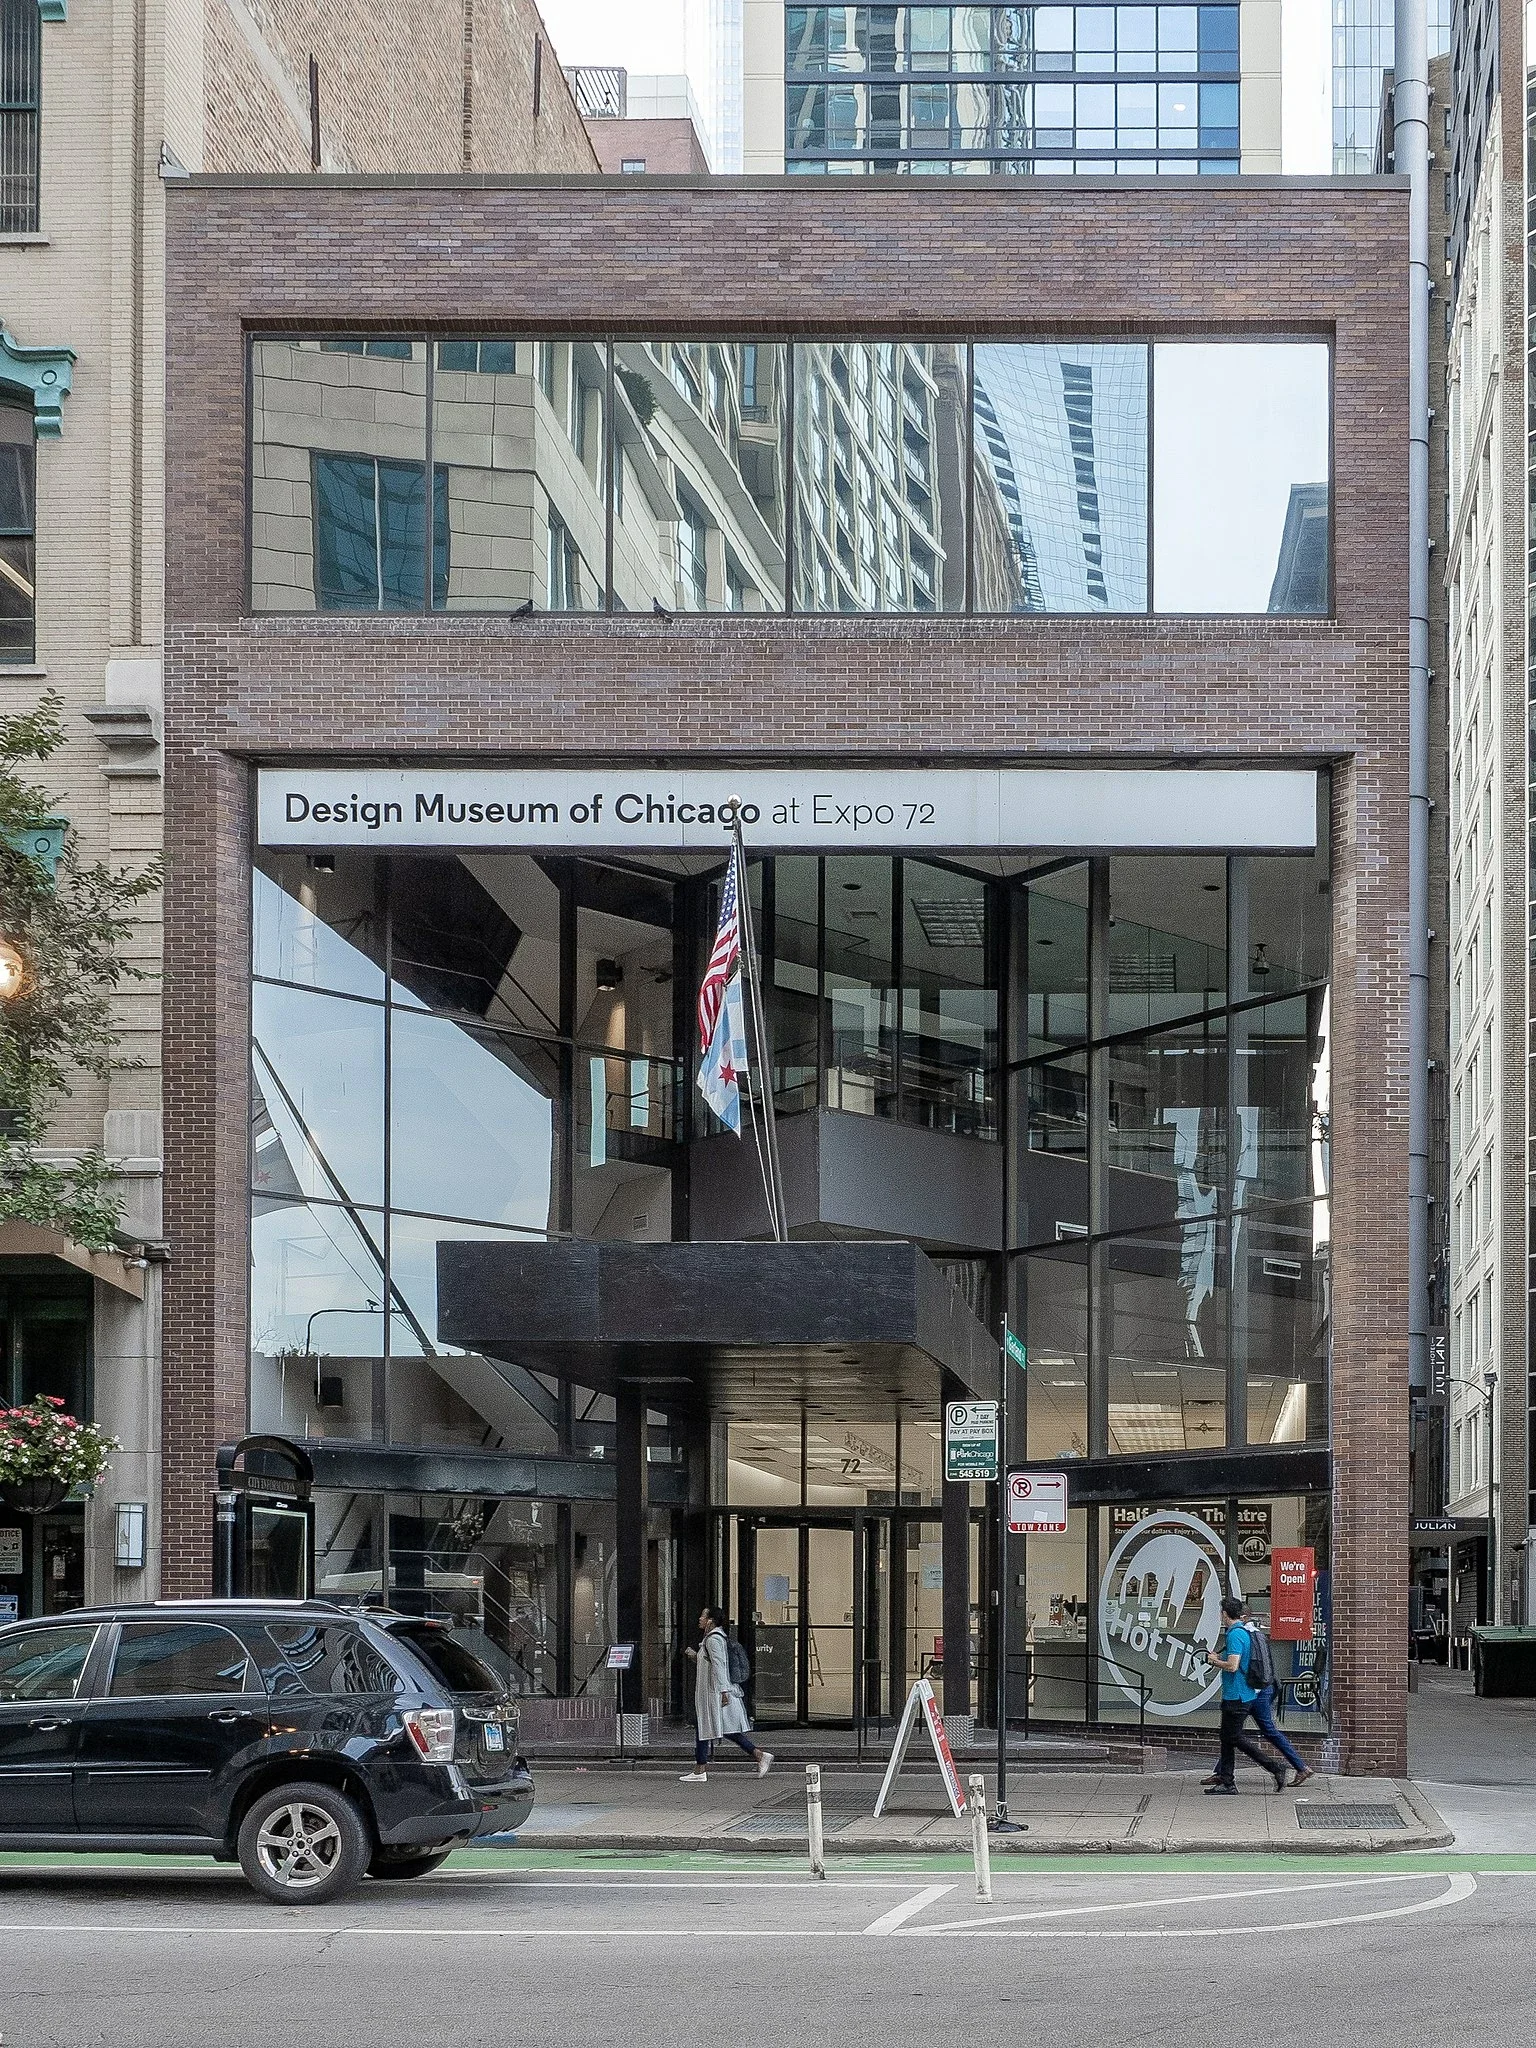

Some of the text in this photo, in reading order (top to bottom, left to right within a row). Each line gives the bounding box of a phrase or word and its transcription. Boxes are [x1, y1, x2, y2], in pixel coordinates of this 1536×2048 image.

[285, 793, 936, 831] Design Museum of Chicago at Expo 72
[1435, 1336, 1446, 1395] JULIAN
[956, 1449, 994, 1459] ParkChicago
[840, 1458, 861, 1474] 72
[958, 1470, 974, 1478] 545
[974, 1470, 990, 1478] 519
[1202, 1507, 1268, 1522] Thatre
[1017, 1523, 1060, 1531] TOW ZONE
[1414, 1522, 1456, 1530] JULIAN
[0, 1530, 20, 1538] OTICE
[1151, 1527, 1173, 1535] dollars.
[1174, 1527, 1191, 1536] Enjoy
[1280, 1561, 1306, 1571] We're
[1280, 1573, 1306, 1586] Open!
[755, 1643, 774, 1653] urity
[1108, 1607, 1163, 1662] Hot
[1165, 1634, 1212, 1689] Tix
[1298, 1652, 1317, 1667] HER
